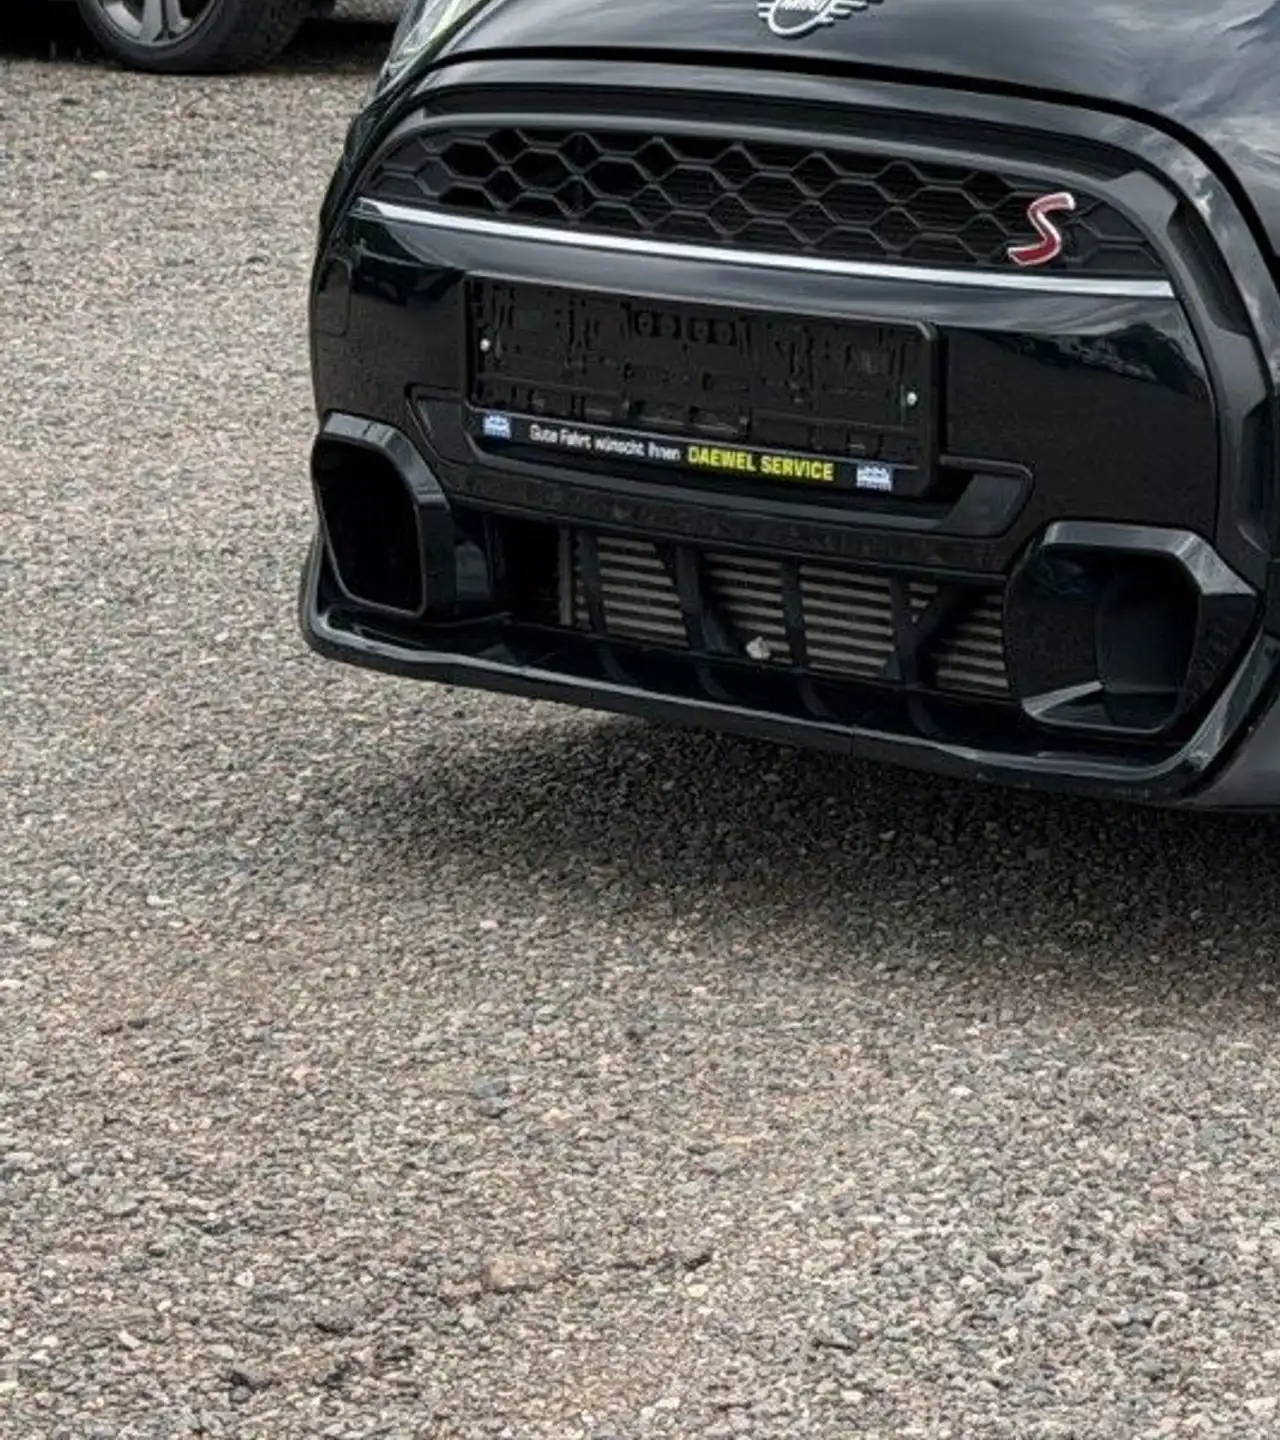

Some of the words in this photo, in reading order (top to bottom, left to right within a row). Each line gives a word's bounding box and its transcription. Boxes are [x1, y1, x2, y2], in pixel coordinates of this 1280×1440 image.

[1008, 191, 1076, 266] S
[687, 446, 757, 472] DAEWEL
[760, 455, 835, 482] SERVICE
